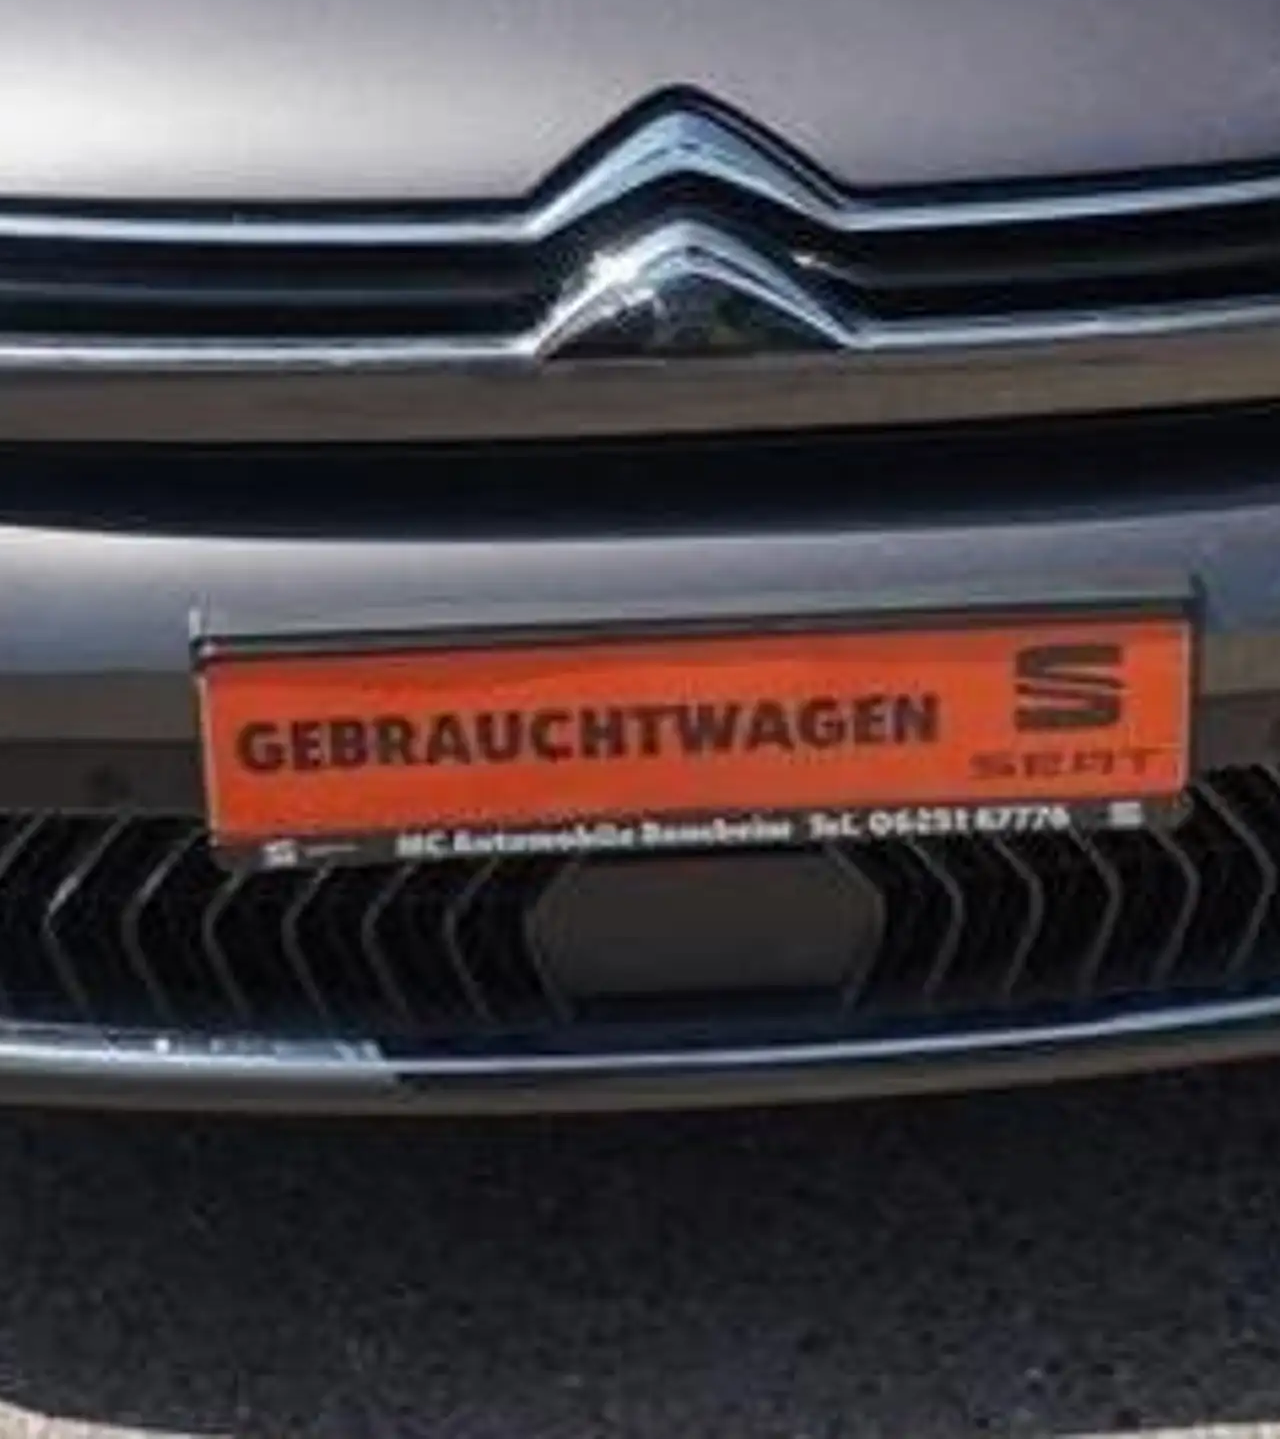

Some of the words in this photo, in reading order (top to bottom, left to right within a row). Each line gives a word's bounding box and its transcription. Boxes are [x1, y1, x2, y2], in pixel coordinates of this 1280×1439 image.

[236, 693, 940, 773] GEBRAUCHTWAGEN
[969, 746, 1162, 779] SEAT
[452, 823, 634, 853] Automobile
